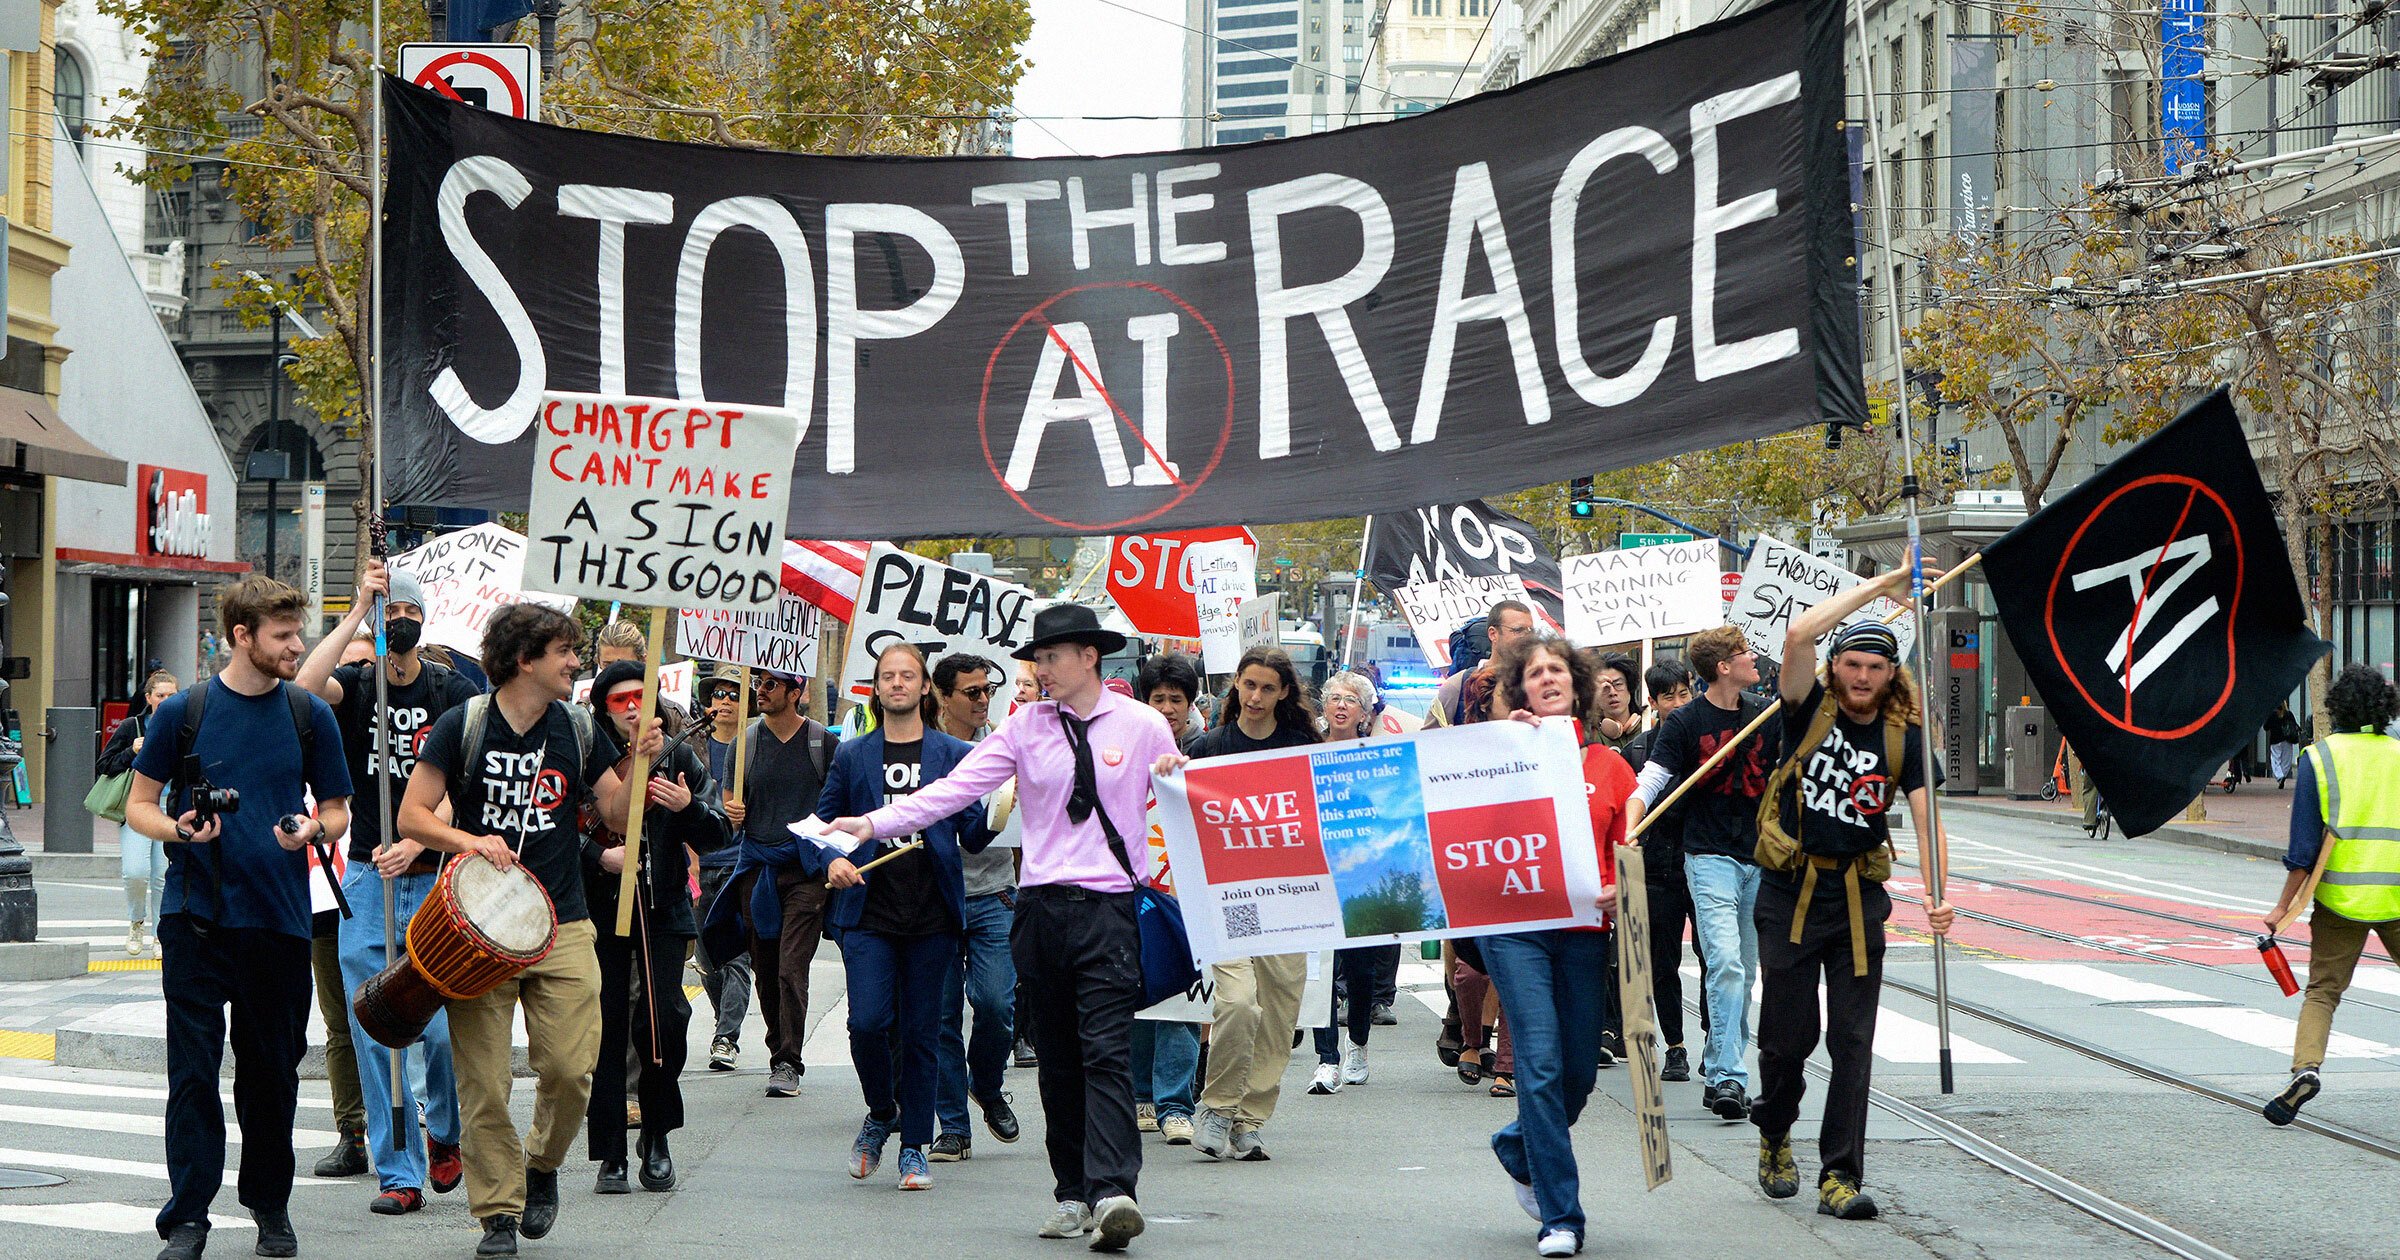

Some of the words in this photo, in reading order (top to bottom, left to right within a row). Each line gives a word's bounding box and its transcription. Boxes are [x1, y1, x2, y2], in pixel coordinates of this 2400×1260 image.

[972, 162, 1227, 276] THE
[1956, 172, 1979, 241] Francisco
[1246, 70, 1801, 460] RACE
[428, 155, 966, 474] STOP
[1004, 312, 1180, 491] AI
[544, 400, 744, 452] CHATGPT
[549, 444, 662, 488] CAN'T
[669, 465, 772, 499] MAKE
[564, 497, 598, 533] A
[626, 499, 773, 556] SIGN
[416, 541, 451, 571] NO
[457, 532, 520, 559] ONE
[1639, 538, 1657, 547] 5th
[1662, 538, 1675, 546] St
[465, 557, 495, 581] IT
[1114, 535, 1200, 594] ST
[1573, 549, 1650, 575] MAY
[1658, 543, 1716, 566] YOUR
[1764, 546, 1840, 597] ENOUGH
[309, 558, 318, 593] Powell
[1221, 579, 1247, 592] drive
[1397, 586, 1419, 604] IF
[1439, 575, 1519, 599] ANYONE
[1566, 569, 1691, 600] TRAINING
[866, 553, 1034, 648] PLEASE
[1582, 594, 1663, 614] RUNS
[1596, 611, 1685, 635] FAIL
[684, 619, 747, 662] WON'T
[755, 633, 810, 673] WORK
[1951, 677, 1960, 729] POWELL
[367, 753, 415, 779] RAC
[485, 750, 541, 777] STO
[1312, 748, 1380, 767] Billionares
[1382, 746, 1403, 758] are
[1951, 734, 1960, 780] STREET
[1315, 770, 1354, 787] trying
[1356, 769, 1370, 780] to
[1372, 764, 1400, 778] take
[1428, 761, 1539, 784] www.stopai.live
[482, 777, 531, 806] THE
[536, 775, 562, 803] AI
[1318, 789, 1334, 804] all
[1336, 787, 1351, 801] of
[1855, 782, 1886, 807] AI
[481, 801, 556, 833] RACE
[1202, 790, 1300, 825] SAVE
[1320, 808, 1345, 822] this
[1347, 806, 1378, 819] away
[1218, 821, 1305, 850] LIFE
[1322, 827, 1354, 841] from
[1444, 833, 1548, 870] STOP
[1221, 888, 1252, 901] Join
[1254, 886, 1275, 897] On
[1277, 881, 1320, 895] Signal
[1500, 865, 1546, 896] AI
